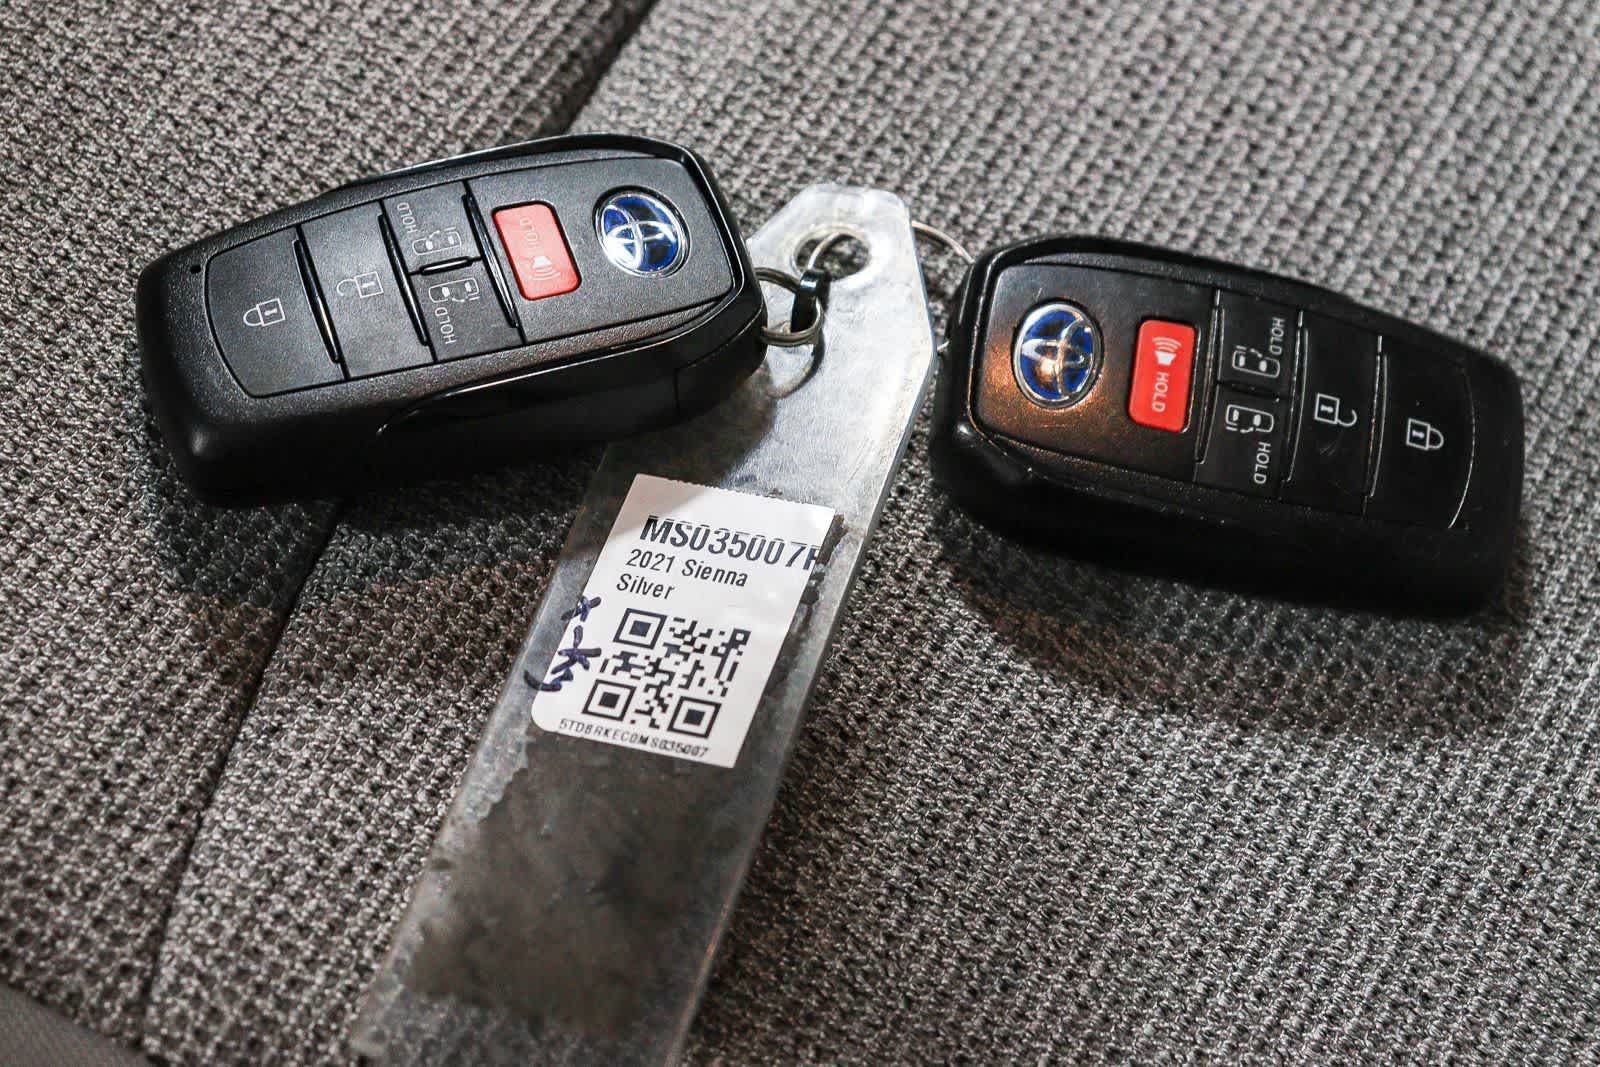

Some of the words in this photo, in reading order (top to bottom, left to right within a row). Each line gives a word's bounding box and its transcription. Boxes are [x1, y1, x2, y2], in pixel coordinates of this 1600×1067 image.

[397, 202, 418, 234] HOLD
[434, 308, 457, 345] HOLD
[1268, 316, 1286, 355] HOLD
[1152, 371, 1170, 413] HOLD
[1253, 441, 1272, 485] HOLD
[616, 573, 676, 600] Silver
[625, 548, 677, 574] 2021
[681, 559, 748, 587] Sienna
